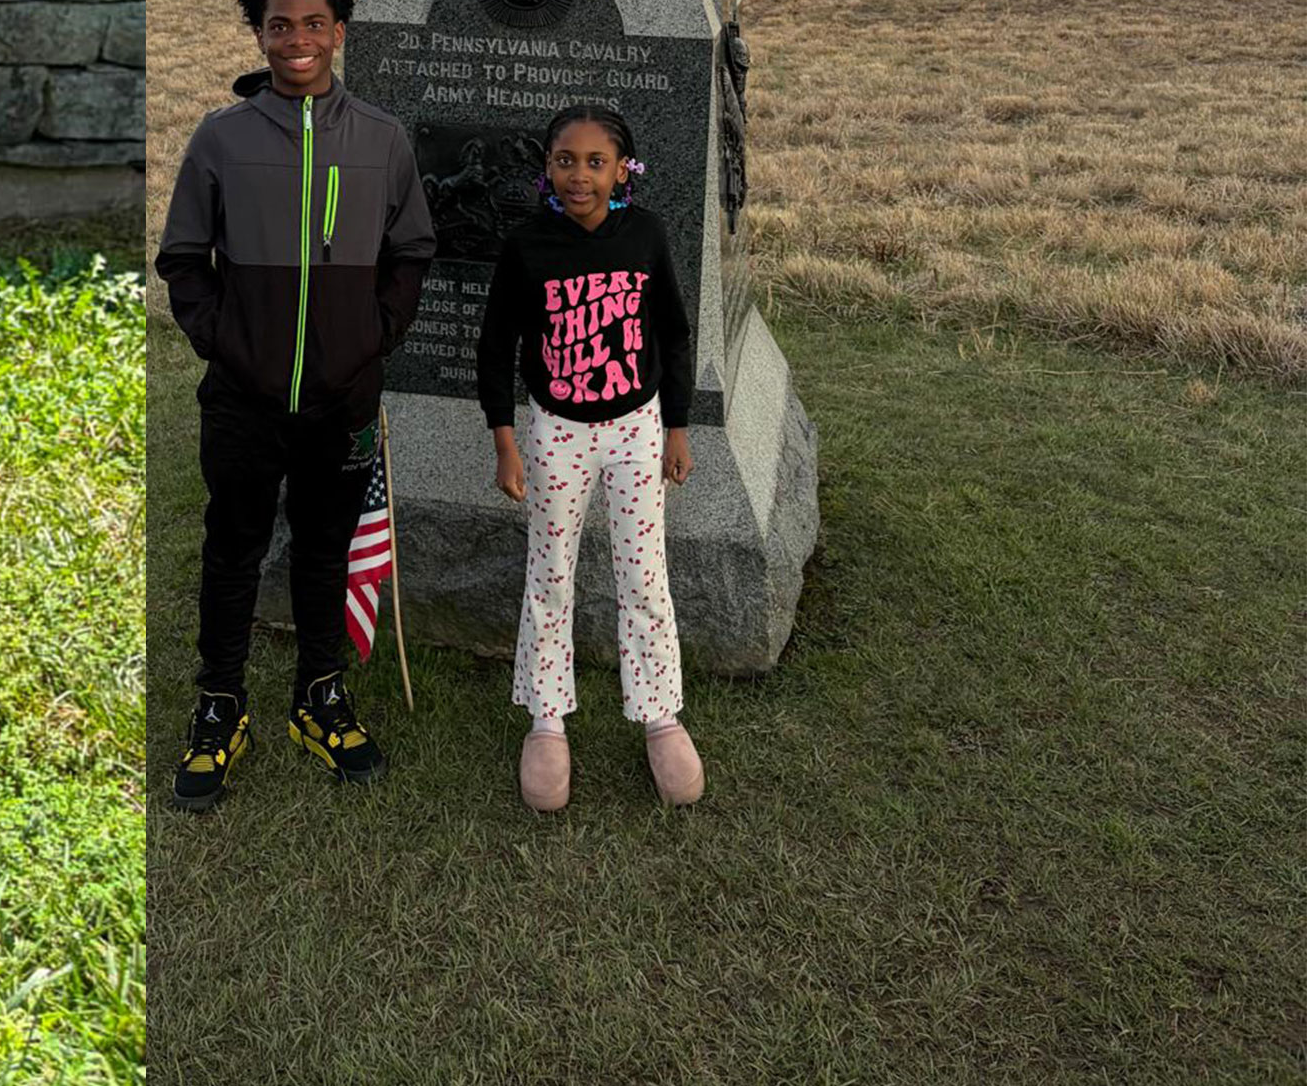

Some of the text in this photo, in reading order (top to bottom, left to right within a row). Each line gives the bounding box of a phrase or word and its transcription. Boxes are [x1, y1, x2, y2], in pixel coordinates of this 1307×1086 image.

[431, 31, 560, 59] PENNSYLVANIA
[377, 57, 473, 80] ATTACHED
[483, 63, 506, 81] TO
[513, 62, 598, 86] PROVOST
[421, 82, 476, 104] ARMY
[544, 270, 650, 312] EVERY
[462, 303, 481, 316] OF
[549, 290, 642, 348] THING
[463, 324, 482, 339] TO
[404, 340, 457, 358] SERVED
[542, 332, 611, 379] WILL
[622, 317, 643, 352] BE
